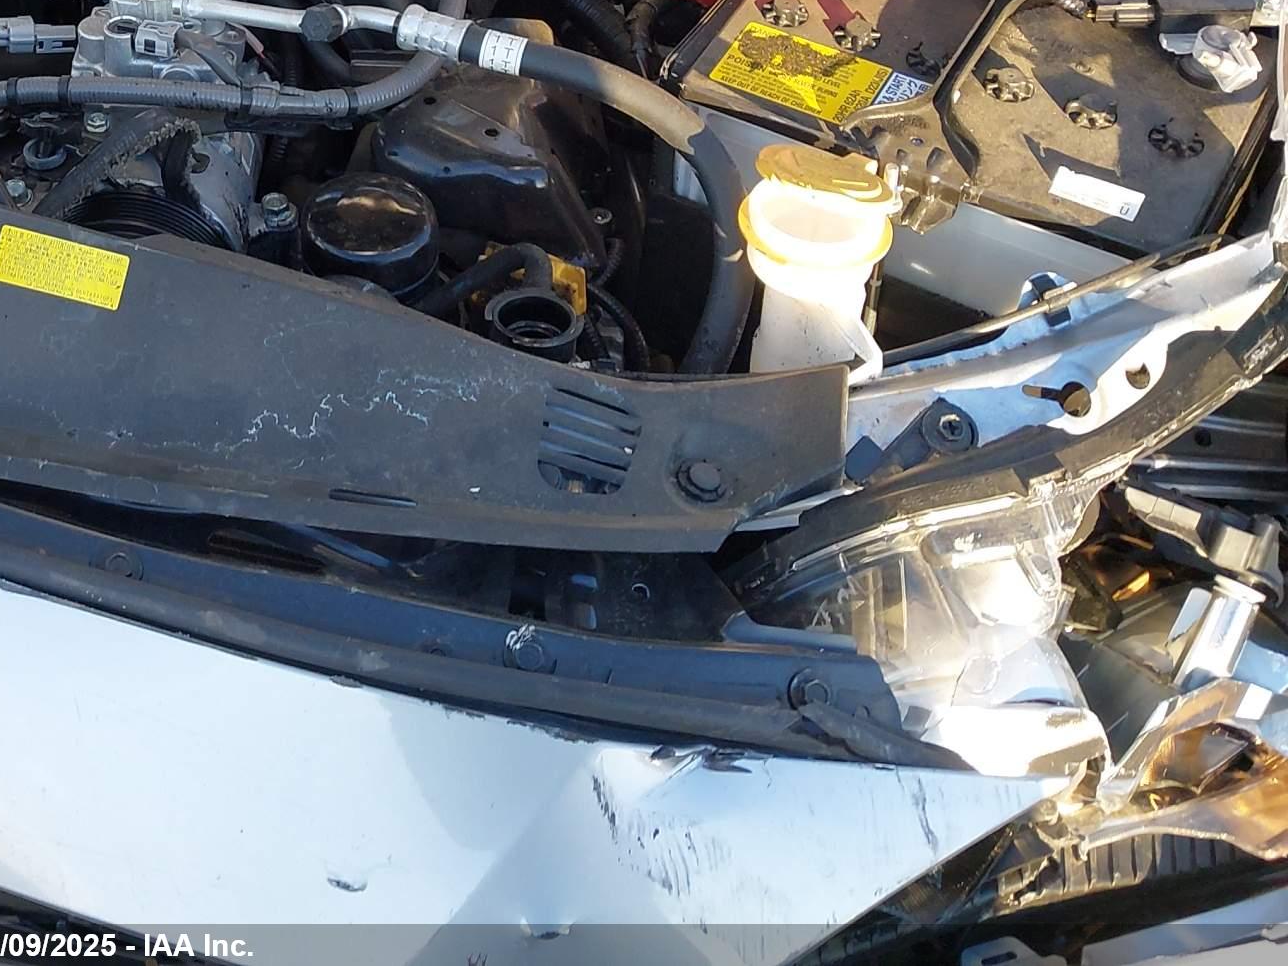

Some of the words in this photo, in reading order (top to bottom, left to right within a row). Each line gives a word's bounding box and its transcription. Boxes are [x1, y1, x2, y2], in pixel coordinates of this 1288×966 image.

[720, 75, 737, 85] KEEP
[737, 80, 750, 89] OUT
[759, 87, 781, 101] REACH
